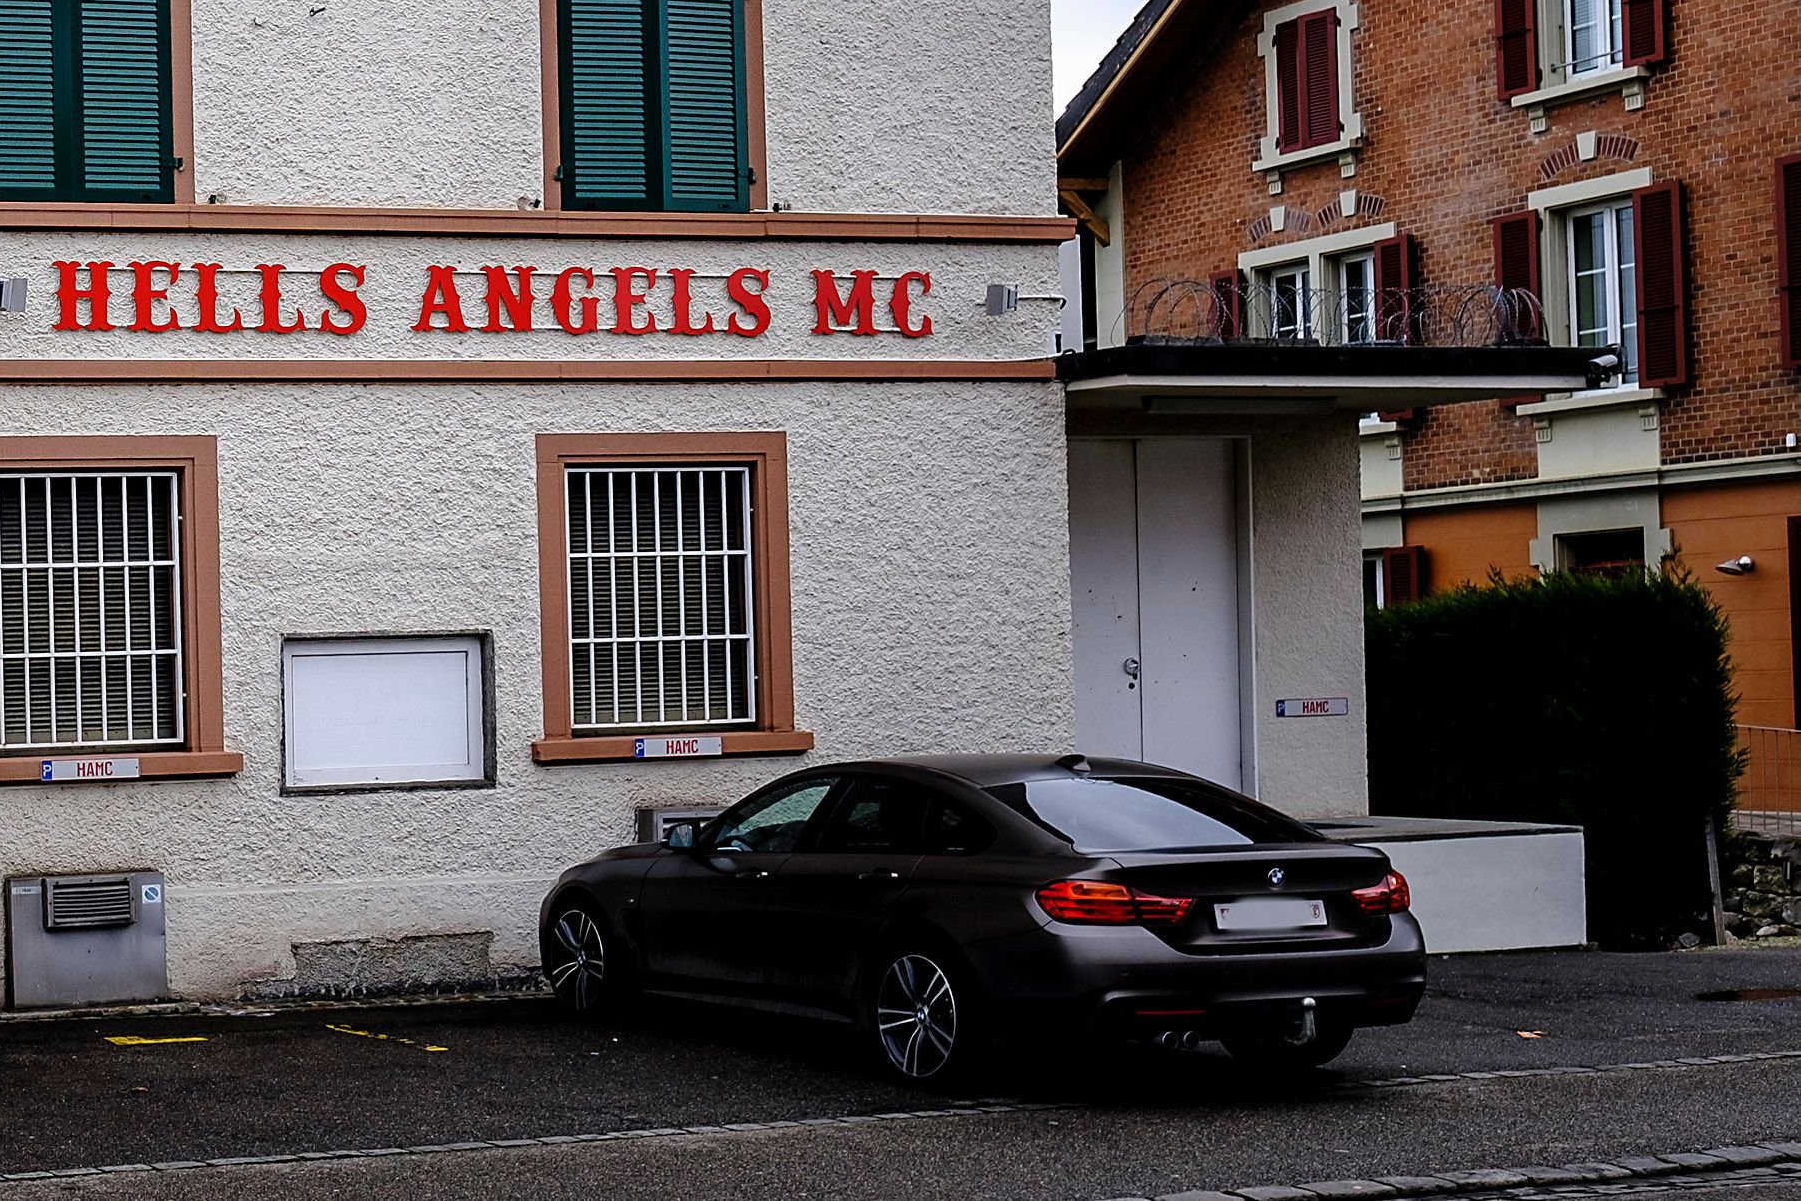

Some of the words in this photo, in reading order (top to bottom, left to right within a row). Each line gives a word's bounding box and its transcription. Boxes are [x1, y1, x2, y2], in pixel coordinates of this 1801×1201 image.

[52, 260, 368, 336] HELLS
[410, 264, 772, 338] ANGELS
[810, 269, 933, 338] MC
[1302, 700, 1330, 714] HAMC
[666, 739, 699, 755] HAMC
[76, 761, 113, 777] HAMC
